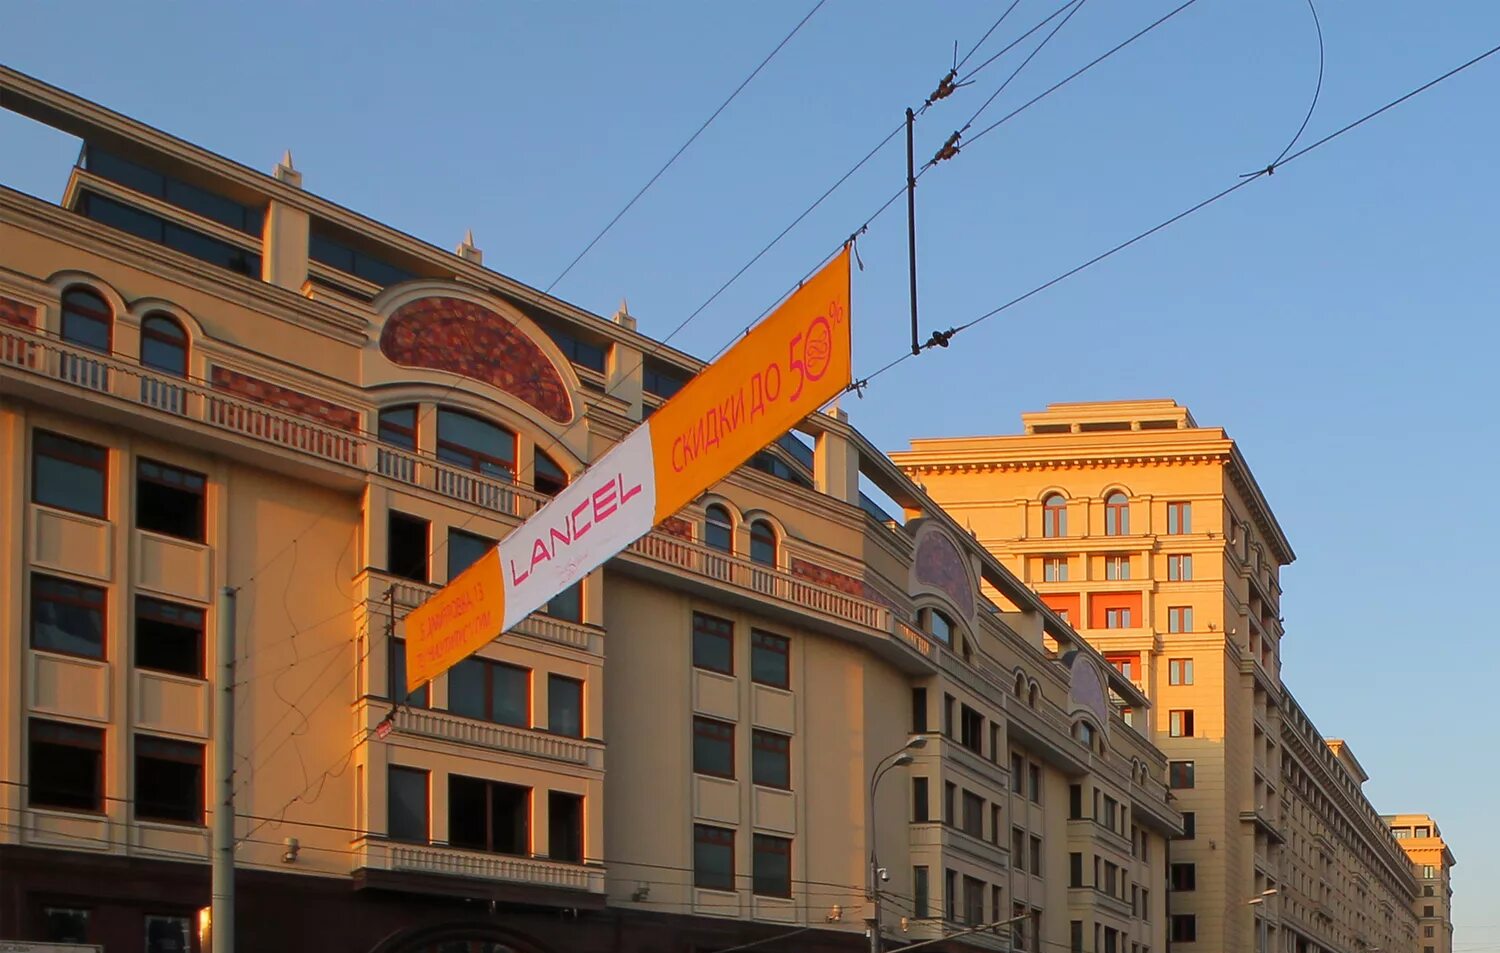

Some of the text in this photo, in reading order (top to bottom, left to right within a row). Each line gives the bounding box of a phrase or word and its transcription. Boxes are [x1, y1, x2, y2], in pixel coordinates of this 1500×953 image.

[671, 387, 745, 473] СКИДКИ
[750, 363, 781, 424] ДО
[509, 472, 643, 587] LANCEL
